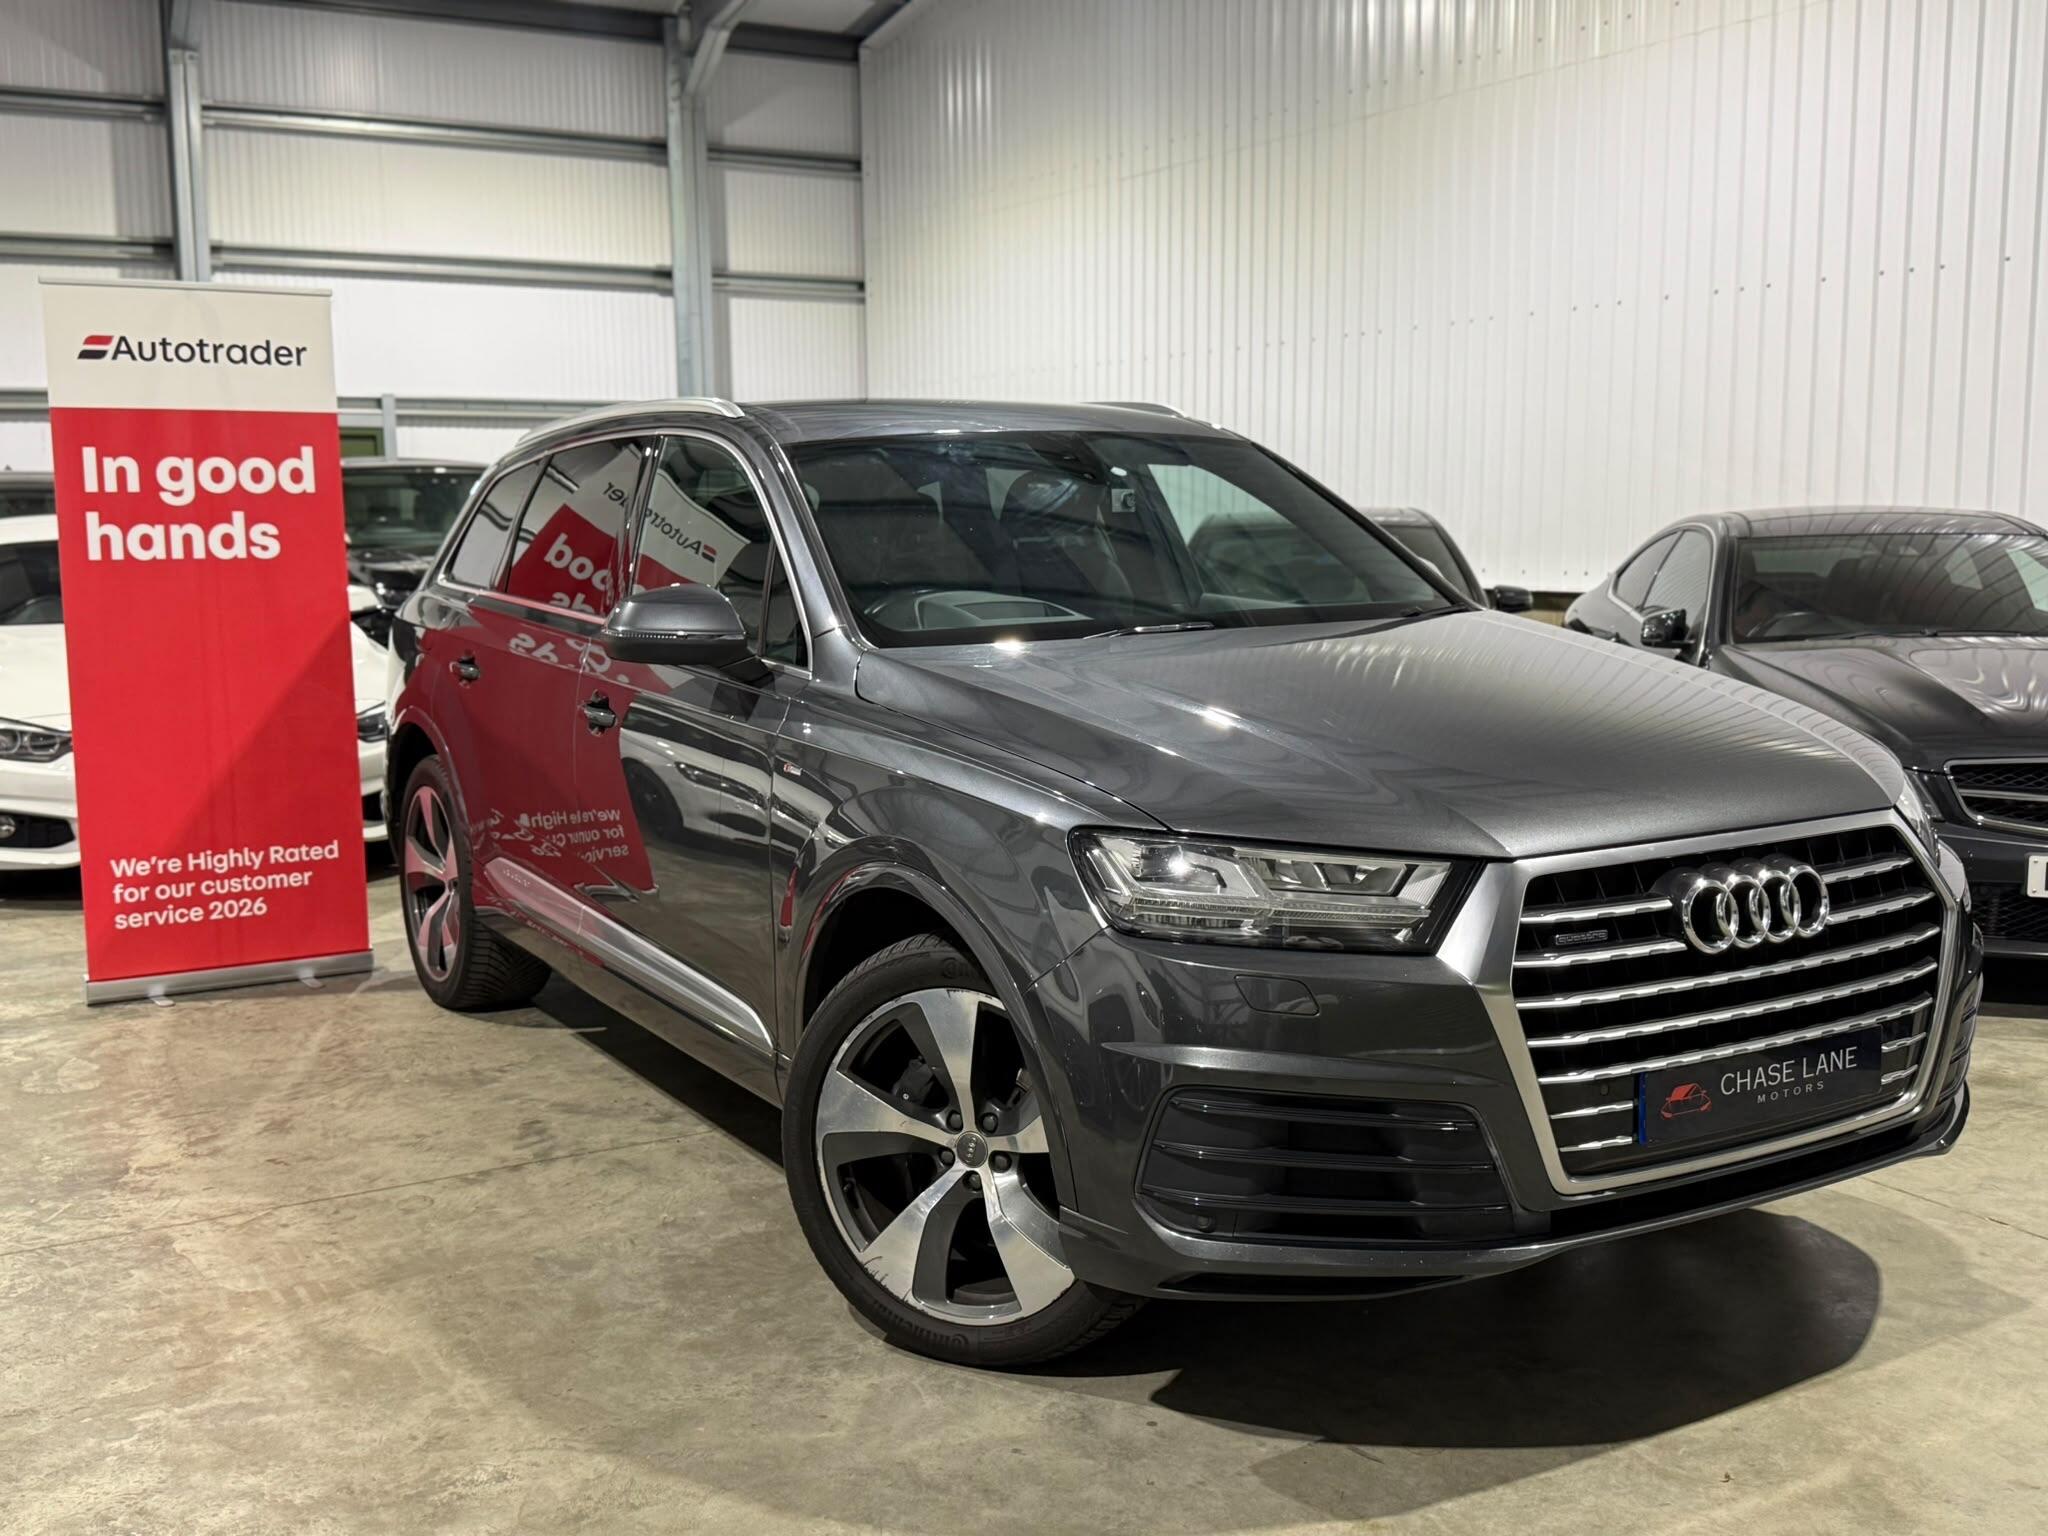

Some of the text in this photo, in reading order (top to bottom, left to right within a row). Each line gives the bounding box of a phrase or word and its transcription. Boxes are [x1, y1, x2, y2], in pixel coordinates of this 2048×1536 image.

[111, 335, 307, 366] Autotrader
[82, 446, 316, 506] In good
[85, 511, 281, 561] hands
[188, 847, 265, 873] Highly
[269, 840, 339, 863] Rated
[112, 869, 313, 904] for our customer
[114, 897, 268, 929] service 2026
[1720, 1046, 1858, 1096] CHASE LANE
[1757, 1081, 1825, 1104] MOTORS
